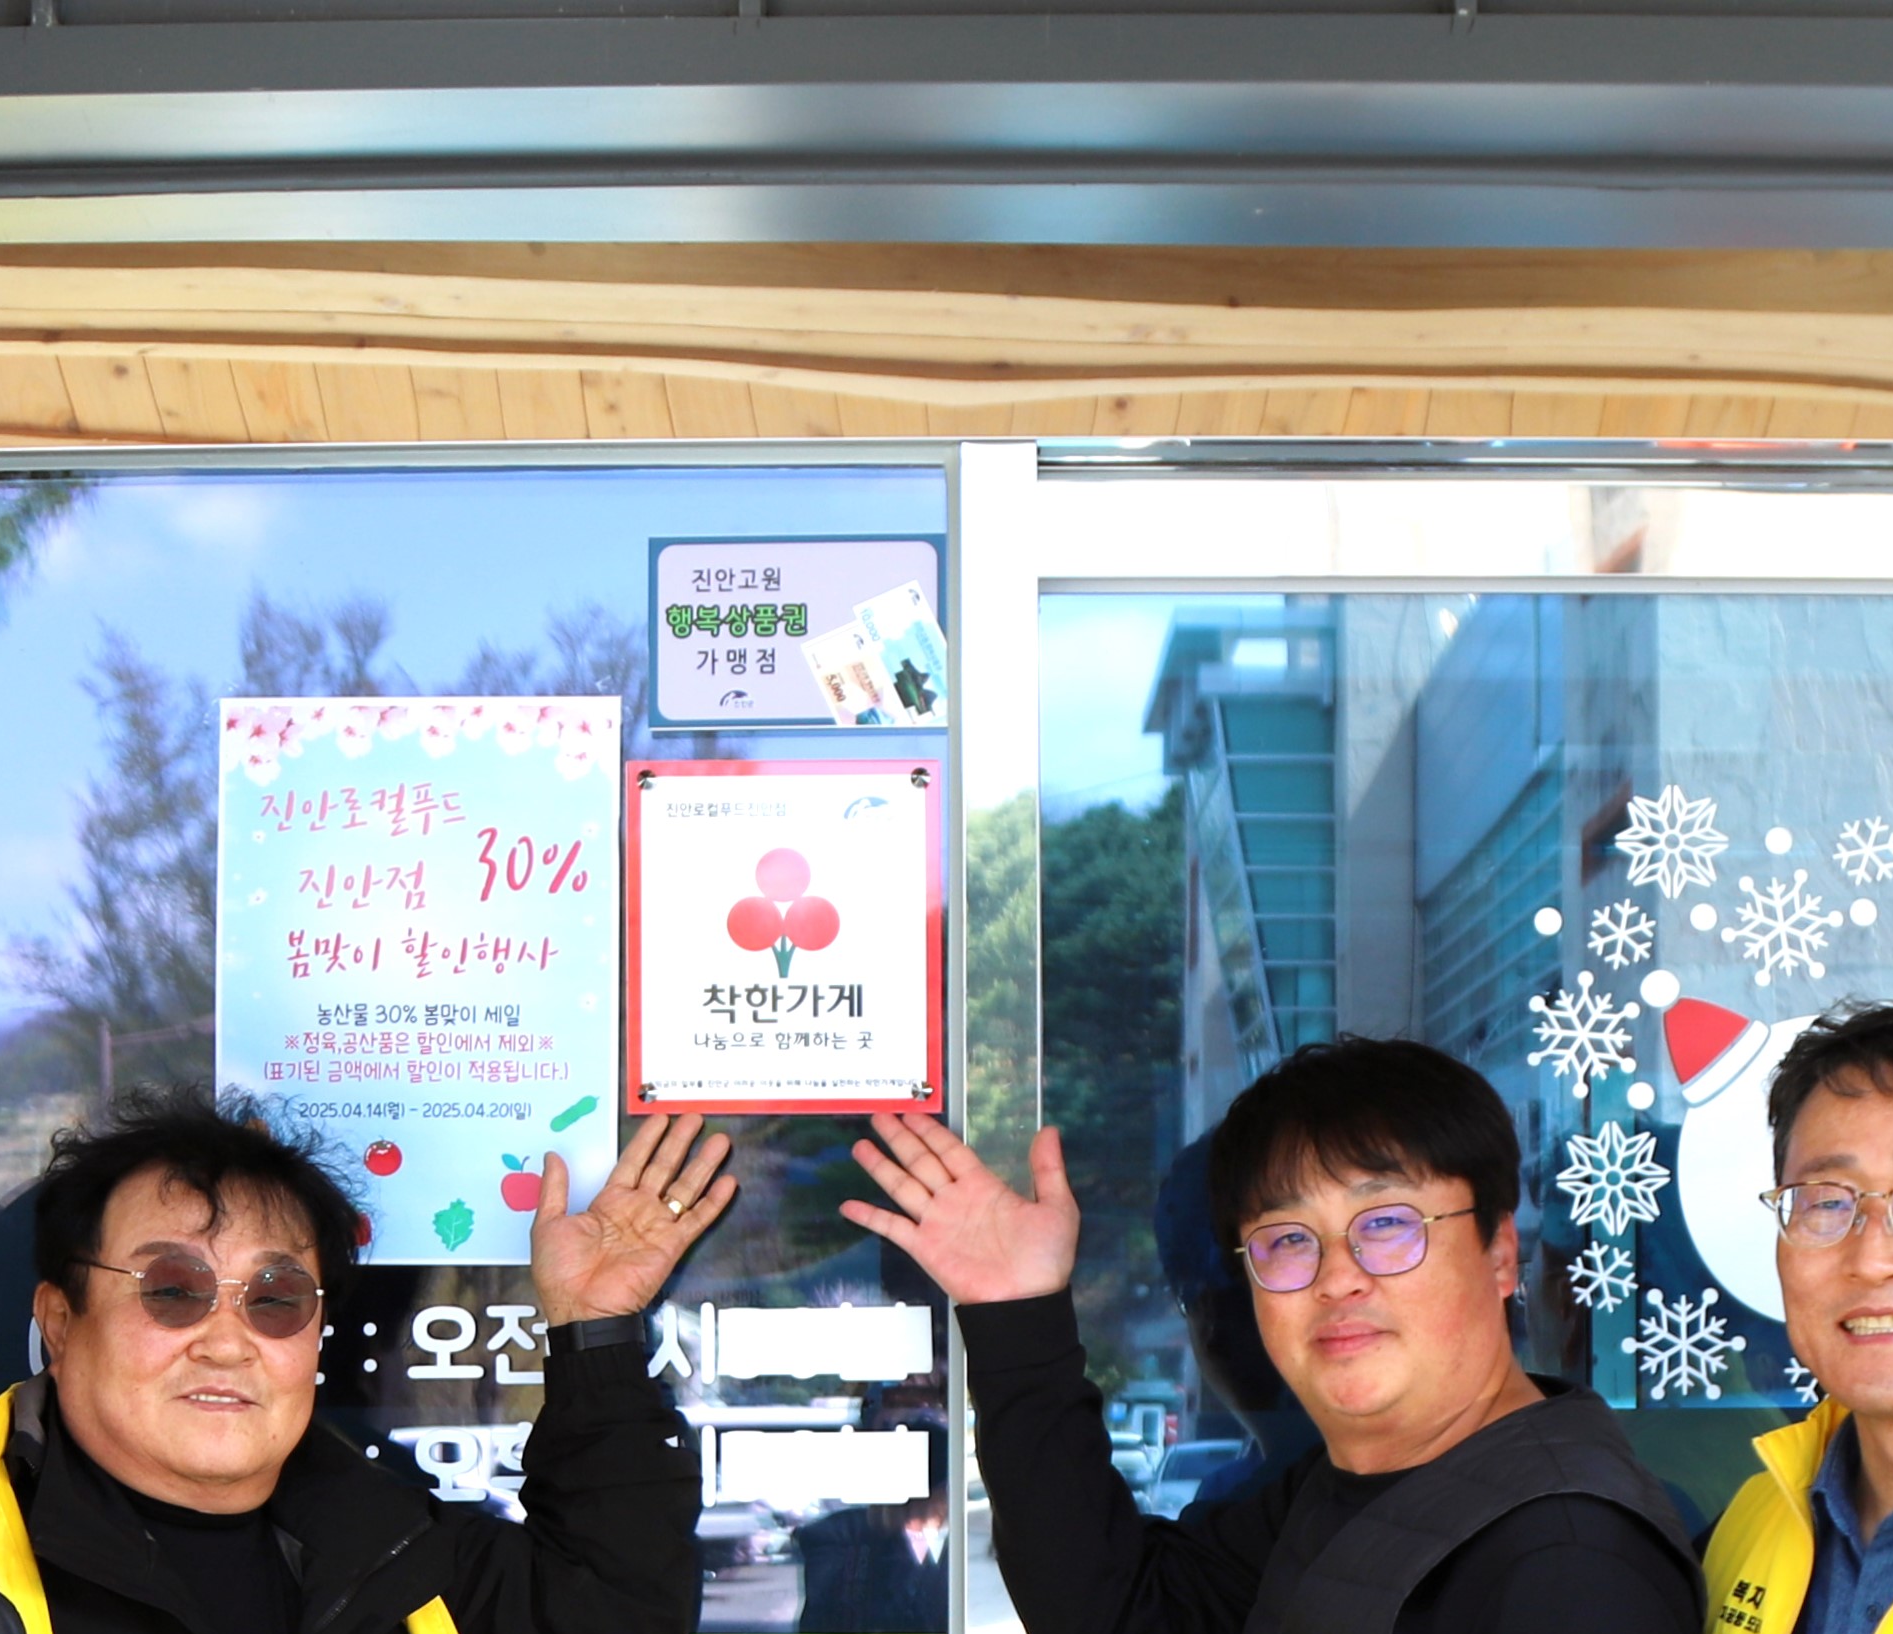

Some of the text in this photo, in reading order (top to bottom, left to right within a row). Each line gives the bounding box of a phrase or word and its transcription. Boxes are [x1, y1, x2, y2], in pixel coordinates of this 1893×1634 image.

[691, 567, 782, 593] 진안고원
[666, 603, 808, 638] 행복상품권
[696, 648, 777, 676] 가맹점
[825, 673, 847, 703] 5,000
[259, 782, 467, 837] 진안로컬푸드
[476, 826, 589, 903] 30%
[298, 860, 427, 911] 진안점
[286, 926, 560, 979] 봄맞이 할인행사
[316, 1003, 521, 1027] 농산물 30% 봄맞이 세일
[702, 984, 864, 1025] 착한가게
[417, 1031, 491, 1055] 할인에서
[694, 1031, 874, 1051] 나눔으로 함께하는 곳
[263, 1059, 569, 1083] (표기된 금액에서 할인이 적용됩니다.)
[299, 1101, 406, 1121] 2025.04.14(월)
[422, 1101, 532, 1121] 2025.04.20(일)
